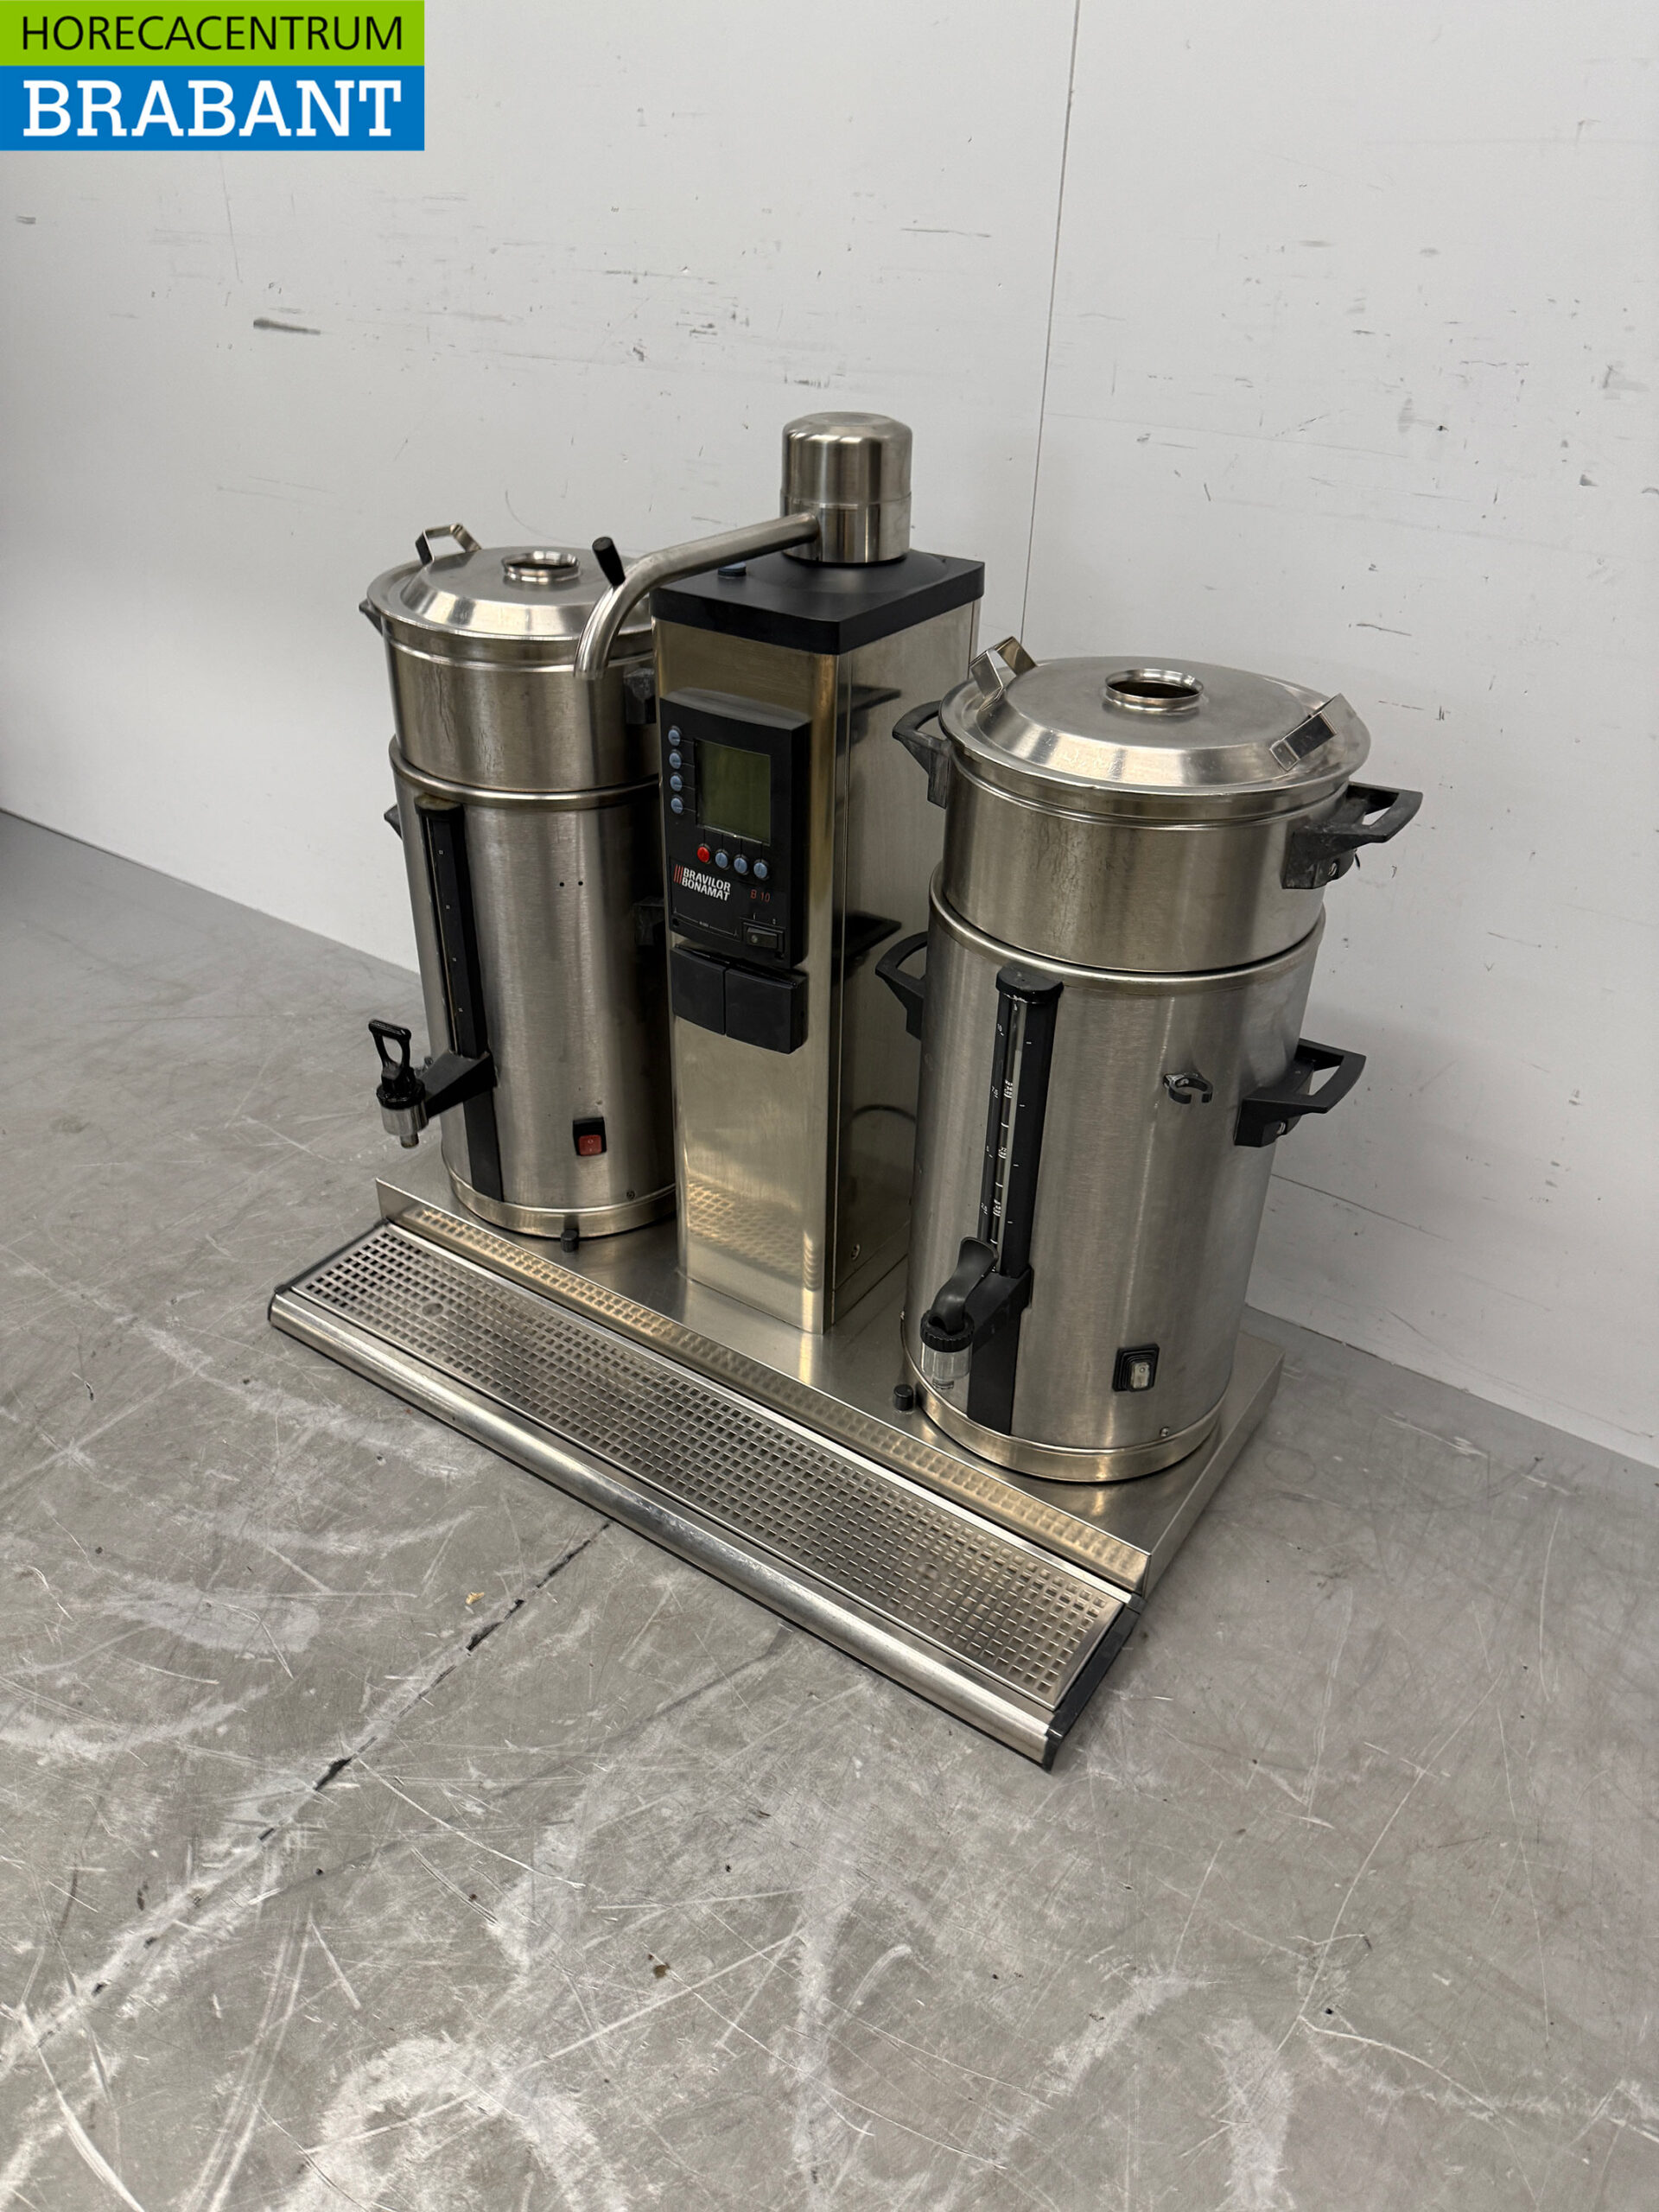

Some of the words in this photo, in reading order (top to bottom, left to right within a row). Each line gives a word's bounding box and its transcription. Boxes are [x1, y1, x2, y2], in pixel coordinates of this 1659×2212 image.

[682, 877, 730, 901] BONAMAT
[683, 867, 731, 893] BRAVILOR
[750, 888, 758, 899] B
[760, 891, 771, 903] 10
